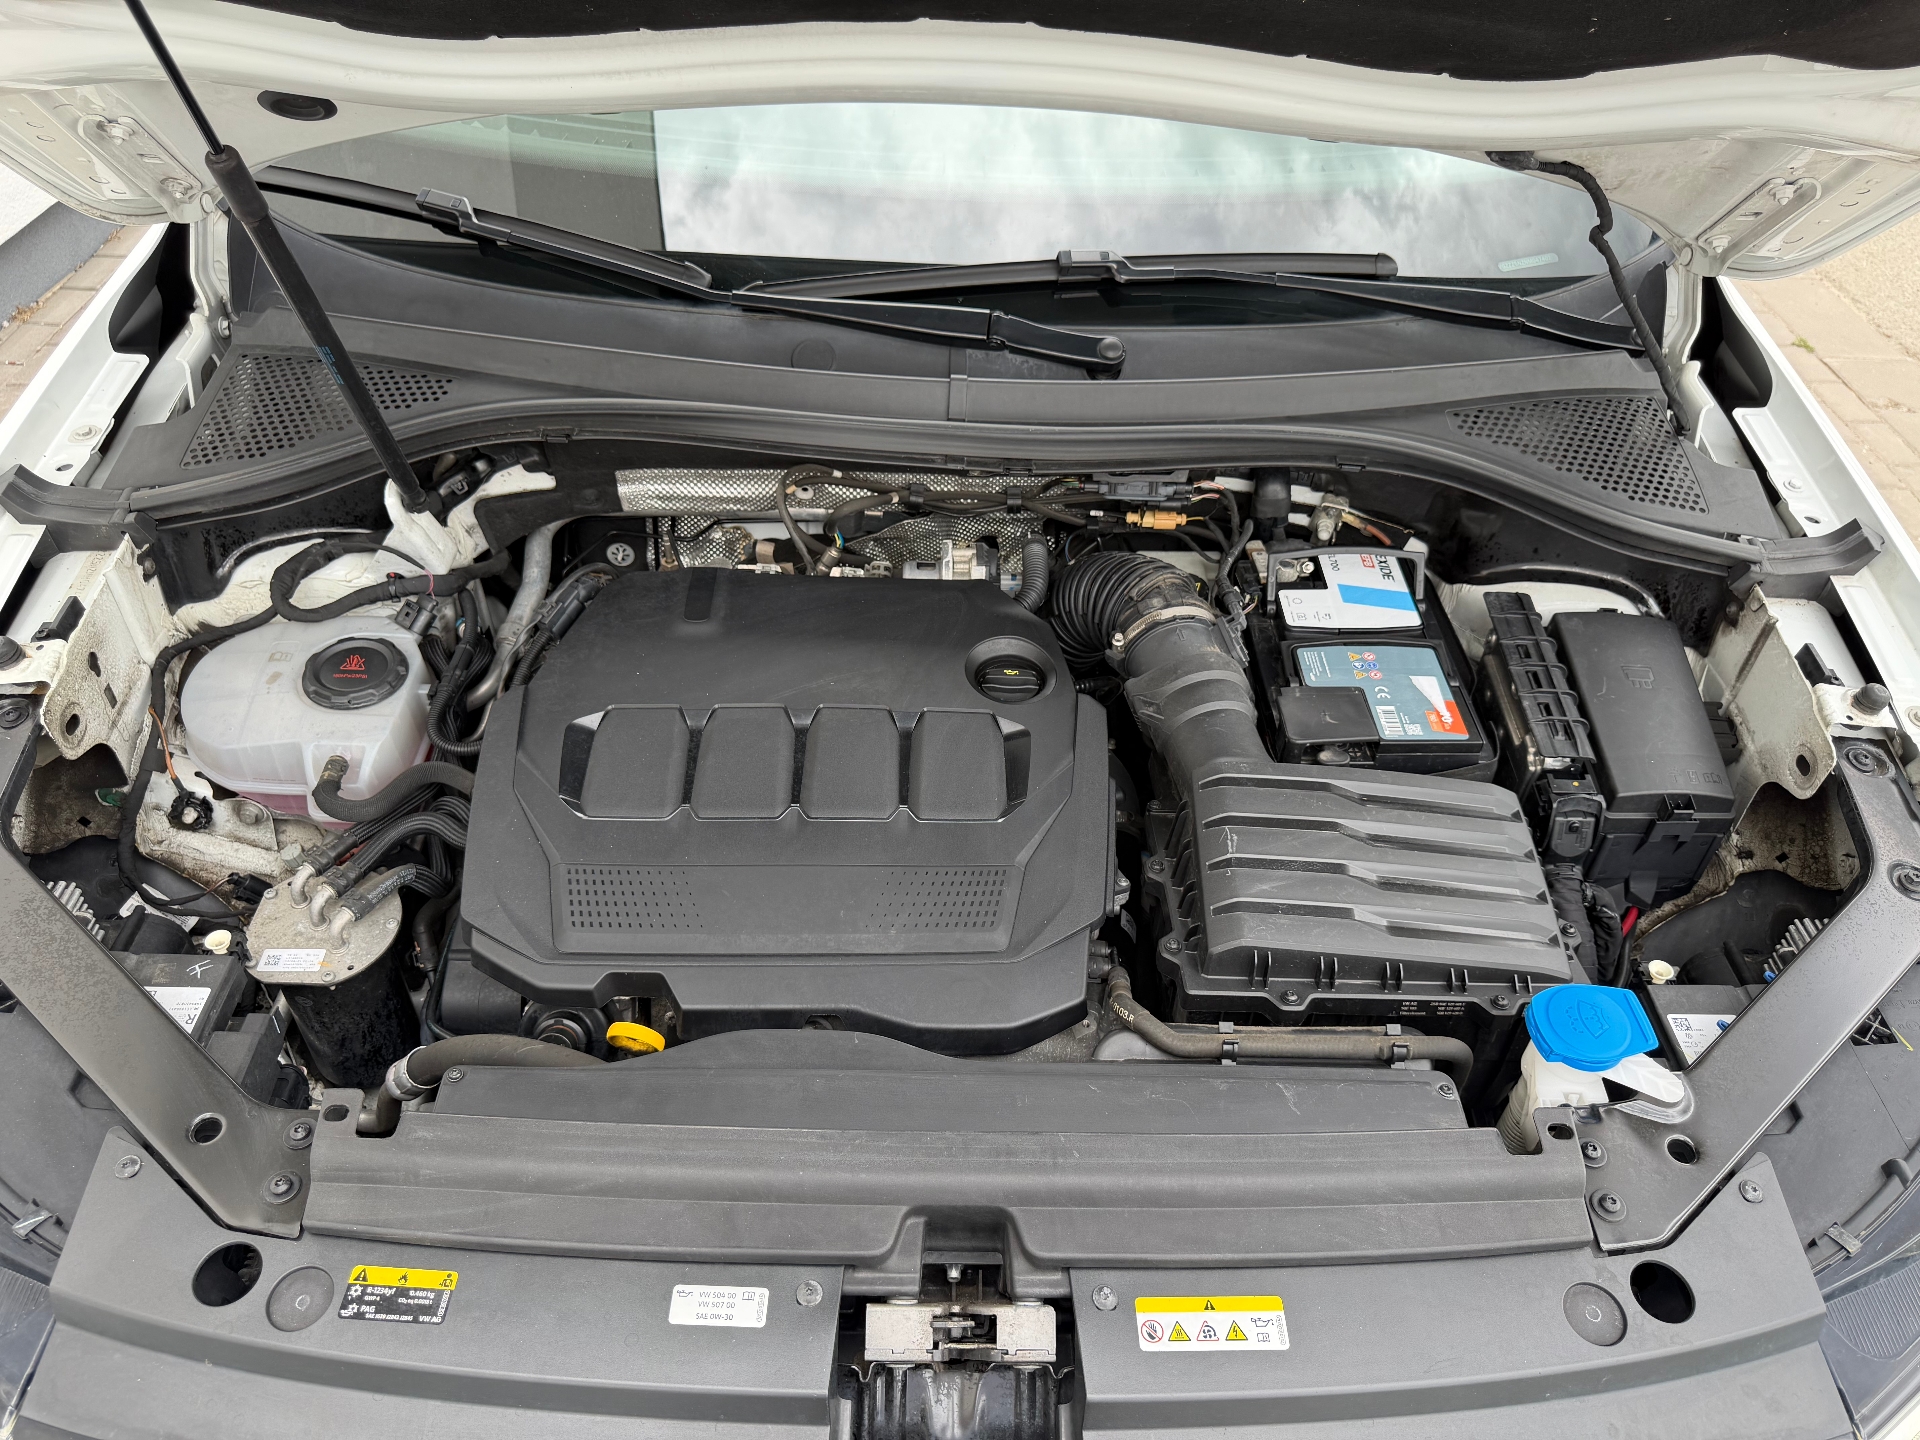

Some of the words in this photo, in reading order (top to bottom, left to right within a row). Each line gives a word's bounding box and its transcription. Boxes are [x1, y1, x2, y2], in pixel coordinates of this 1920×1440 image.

[1375, 554, 1396, 582] EXIDE
[366, 1286, 396, 1297] R-1234yf
[712, 1291, 726, 1299] 504
[727, 1292, 737, 1300] 00
[360, 1304, 376, 1313] PAG
[711, 1301, 725, 1309] 507
[725, 1301, 736, 1309] 00
[695, 1312, 709, 1320] SAE
[709, 1313, 734, 1321] 0W-30
